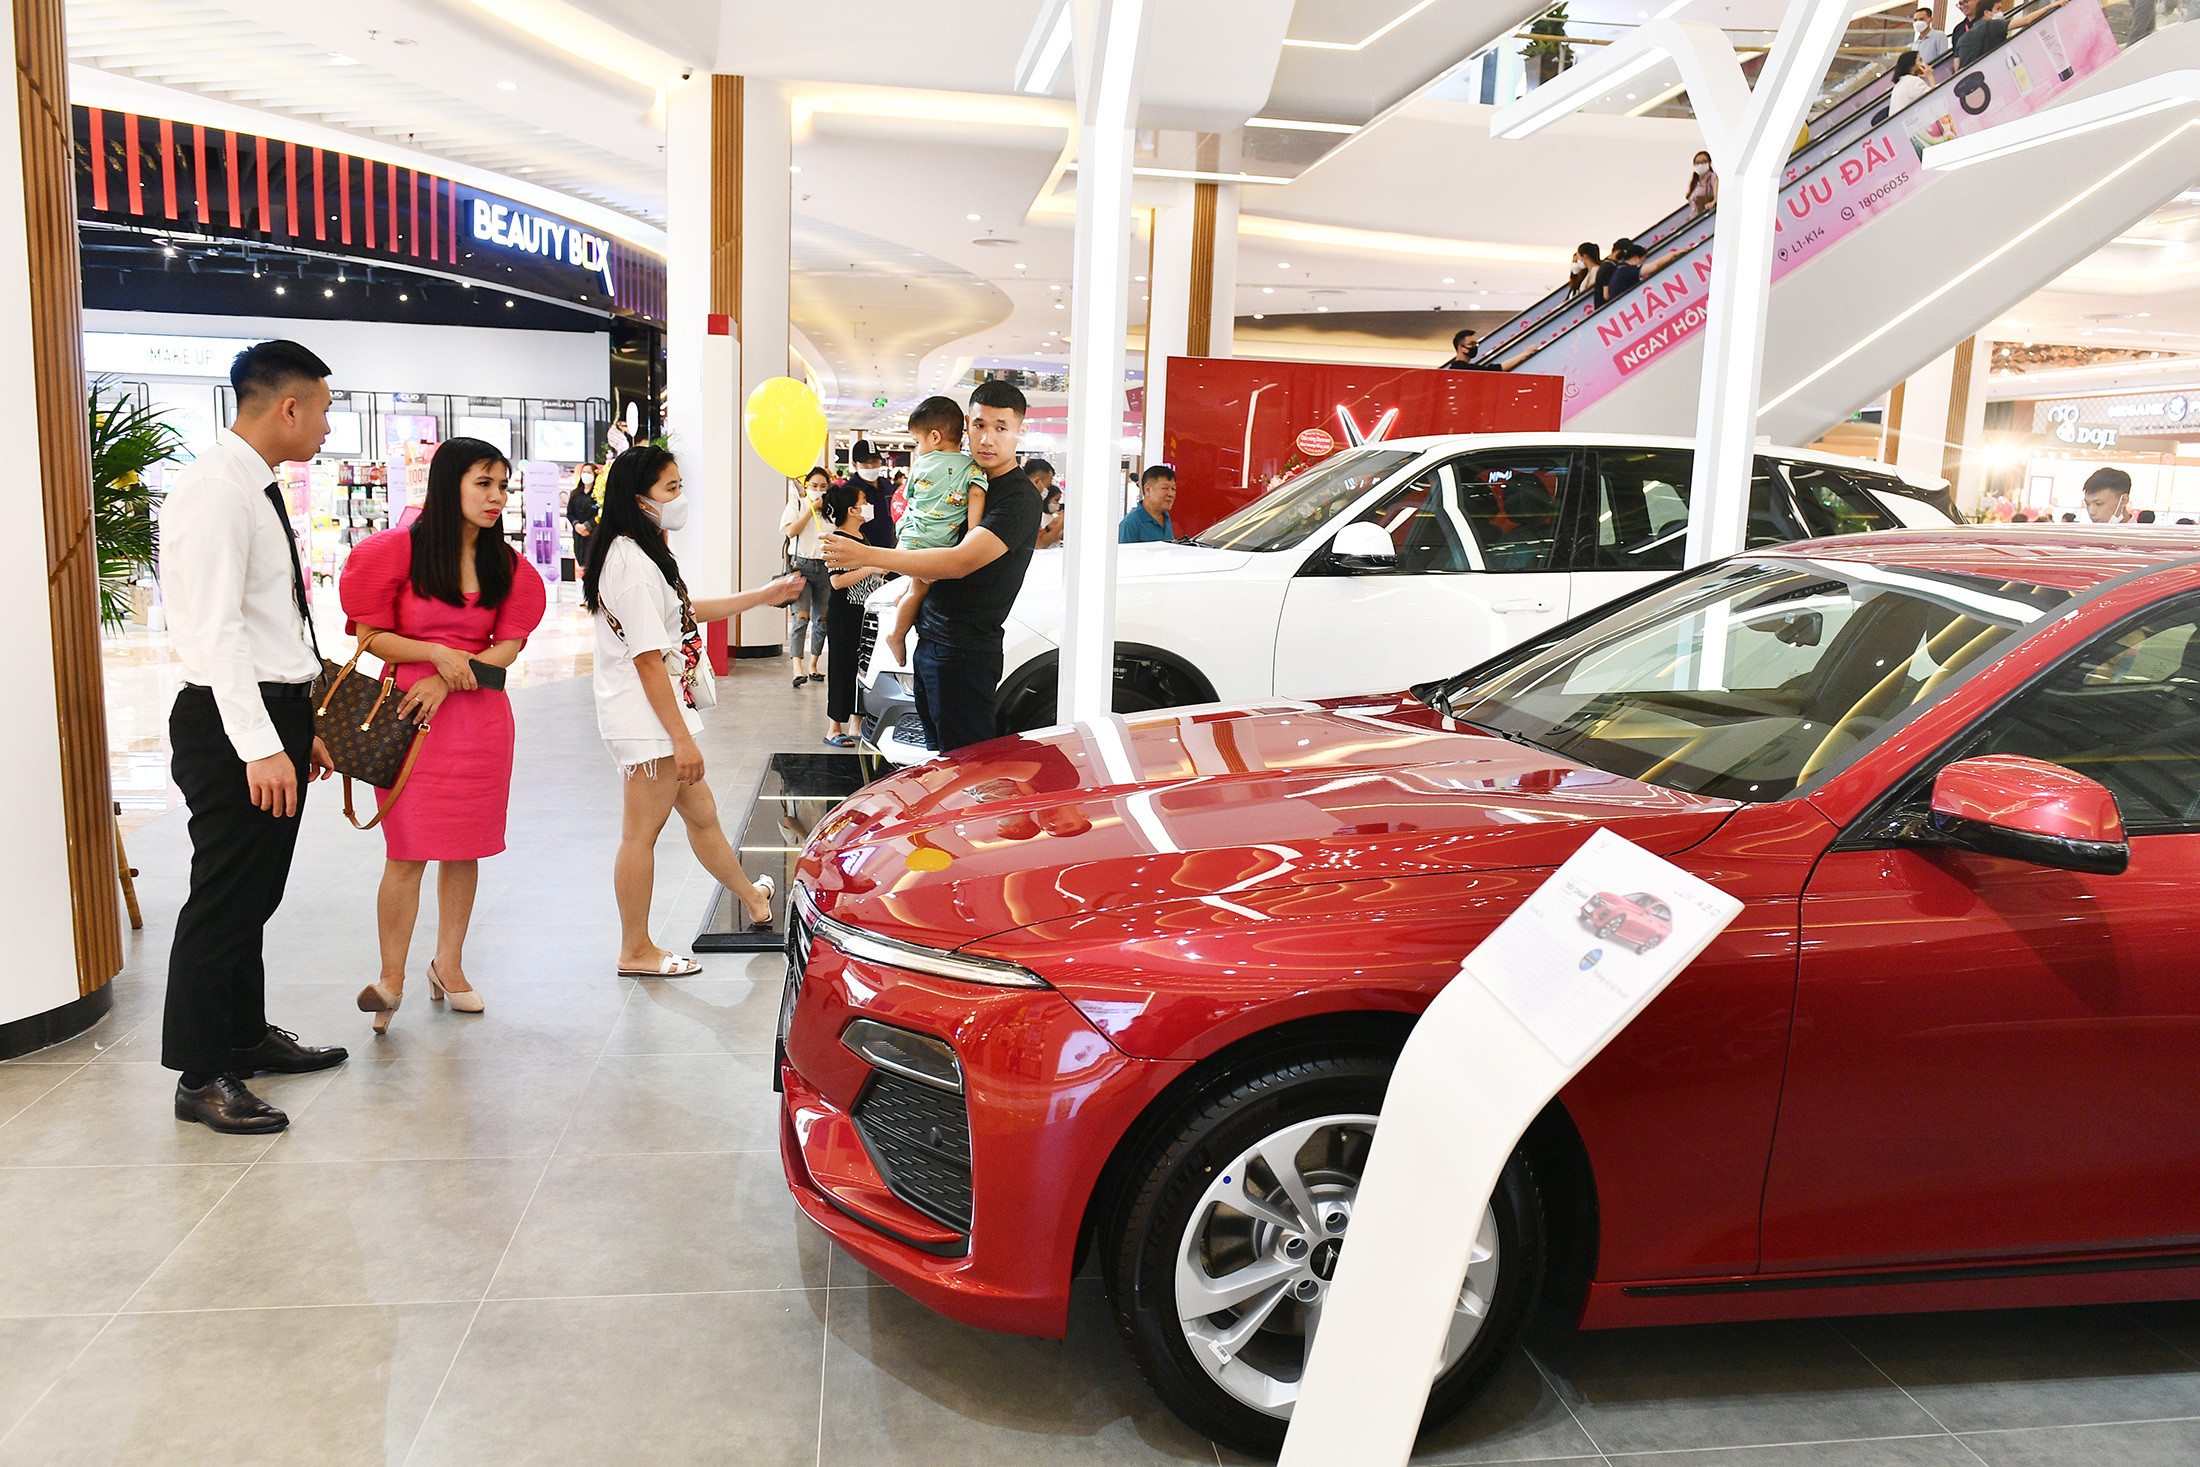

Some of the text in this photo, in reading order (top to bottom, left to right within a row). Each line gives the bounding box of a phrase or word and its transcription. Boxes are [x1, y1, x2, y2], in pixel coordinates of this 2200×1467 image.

[1596, 273, 1689, 347] NHẬN
[1787, 177, 1832, 218] ƯU
[1839, 136, 1896, 186] ĐÃI
[1791, 172, 1909, 253] L1-K14 18006035
[474, 198, 615, 297] BEAUTY BOX
[150, 347, 214, 365] MAKE UP
[1622, 328, 1670, 369] NGAY
[400, 393, 420, 402] CLIO
